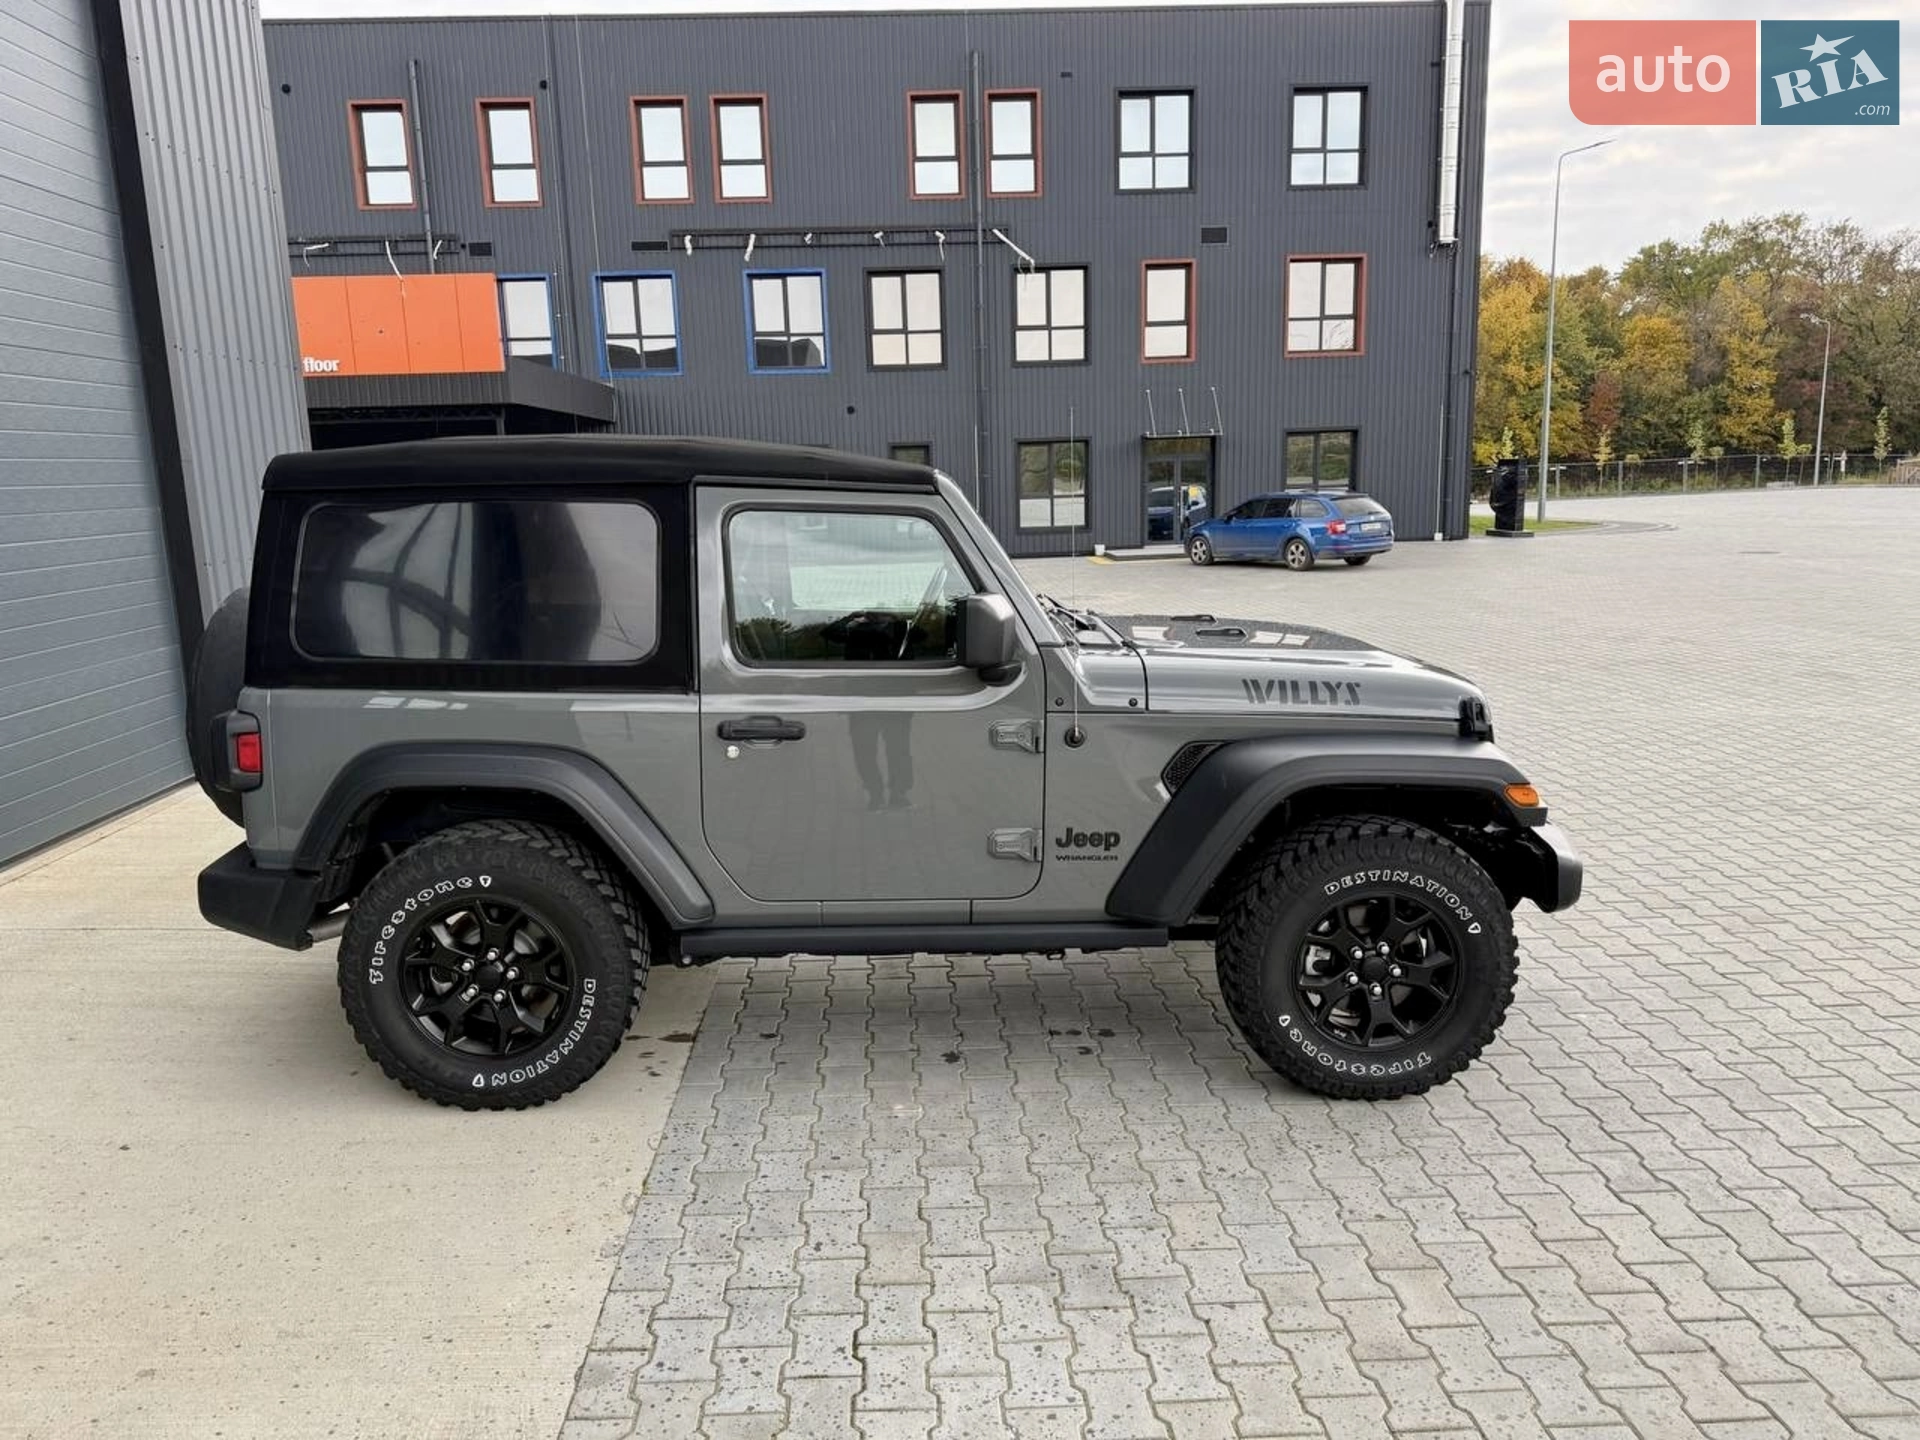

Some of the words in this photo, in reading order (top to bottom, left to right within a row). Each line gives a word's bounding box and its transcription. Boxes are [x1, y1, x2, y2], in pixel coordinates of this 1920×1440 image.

[303, 357, 339, 372] floor
[1242, 679, 1361, 706] WILLYS
[1056, 827, 1121, 851] Jeep
[1324, 870, 1472, 921] DESTINATION
[491, 979, 597, 1087] DESTINATION
